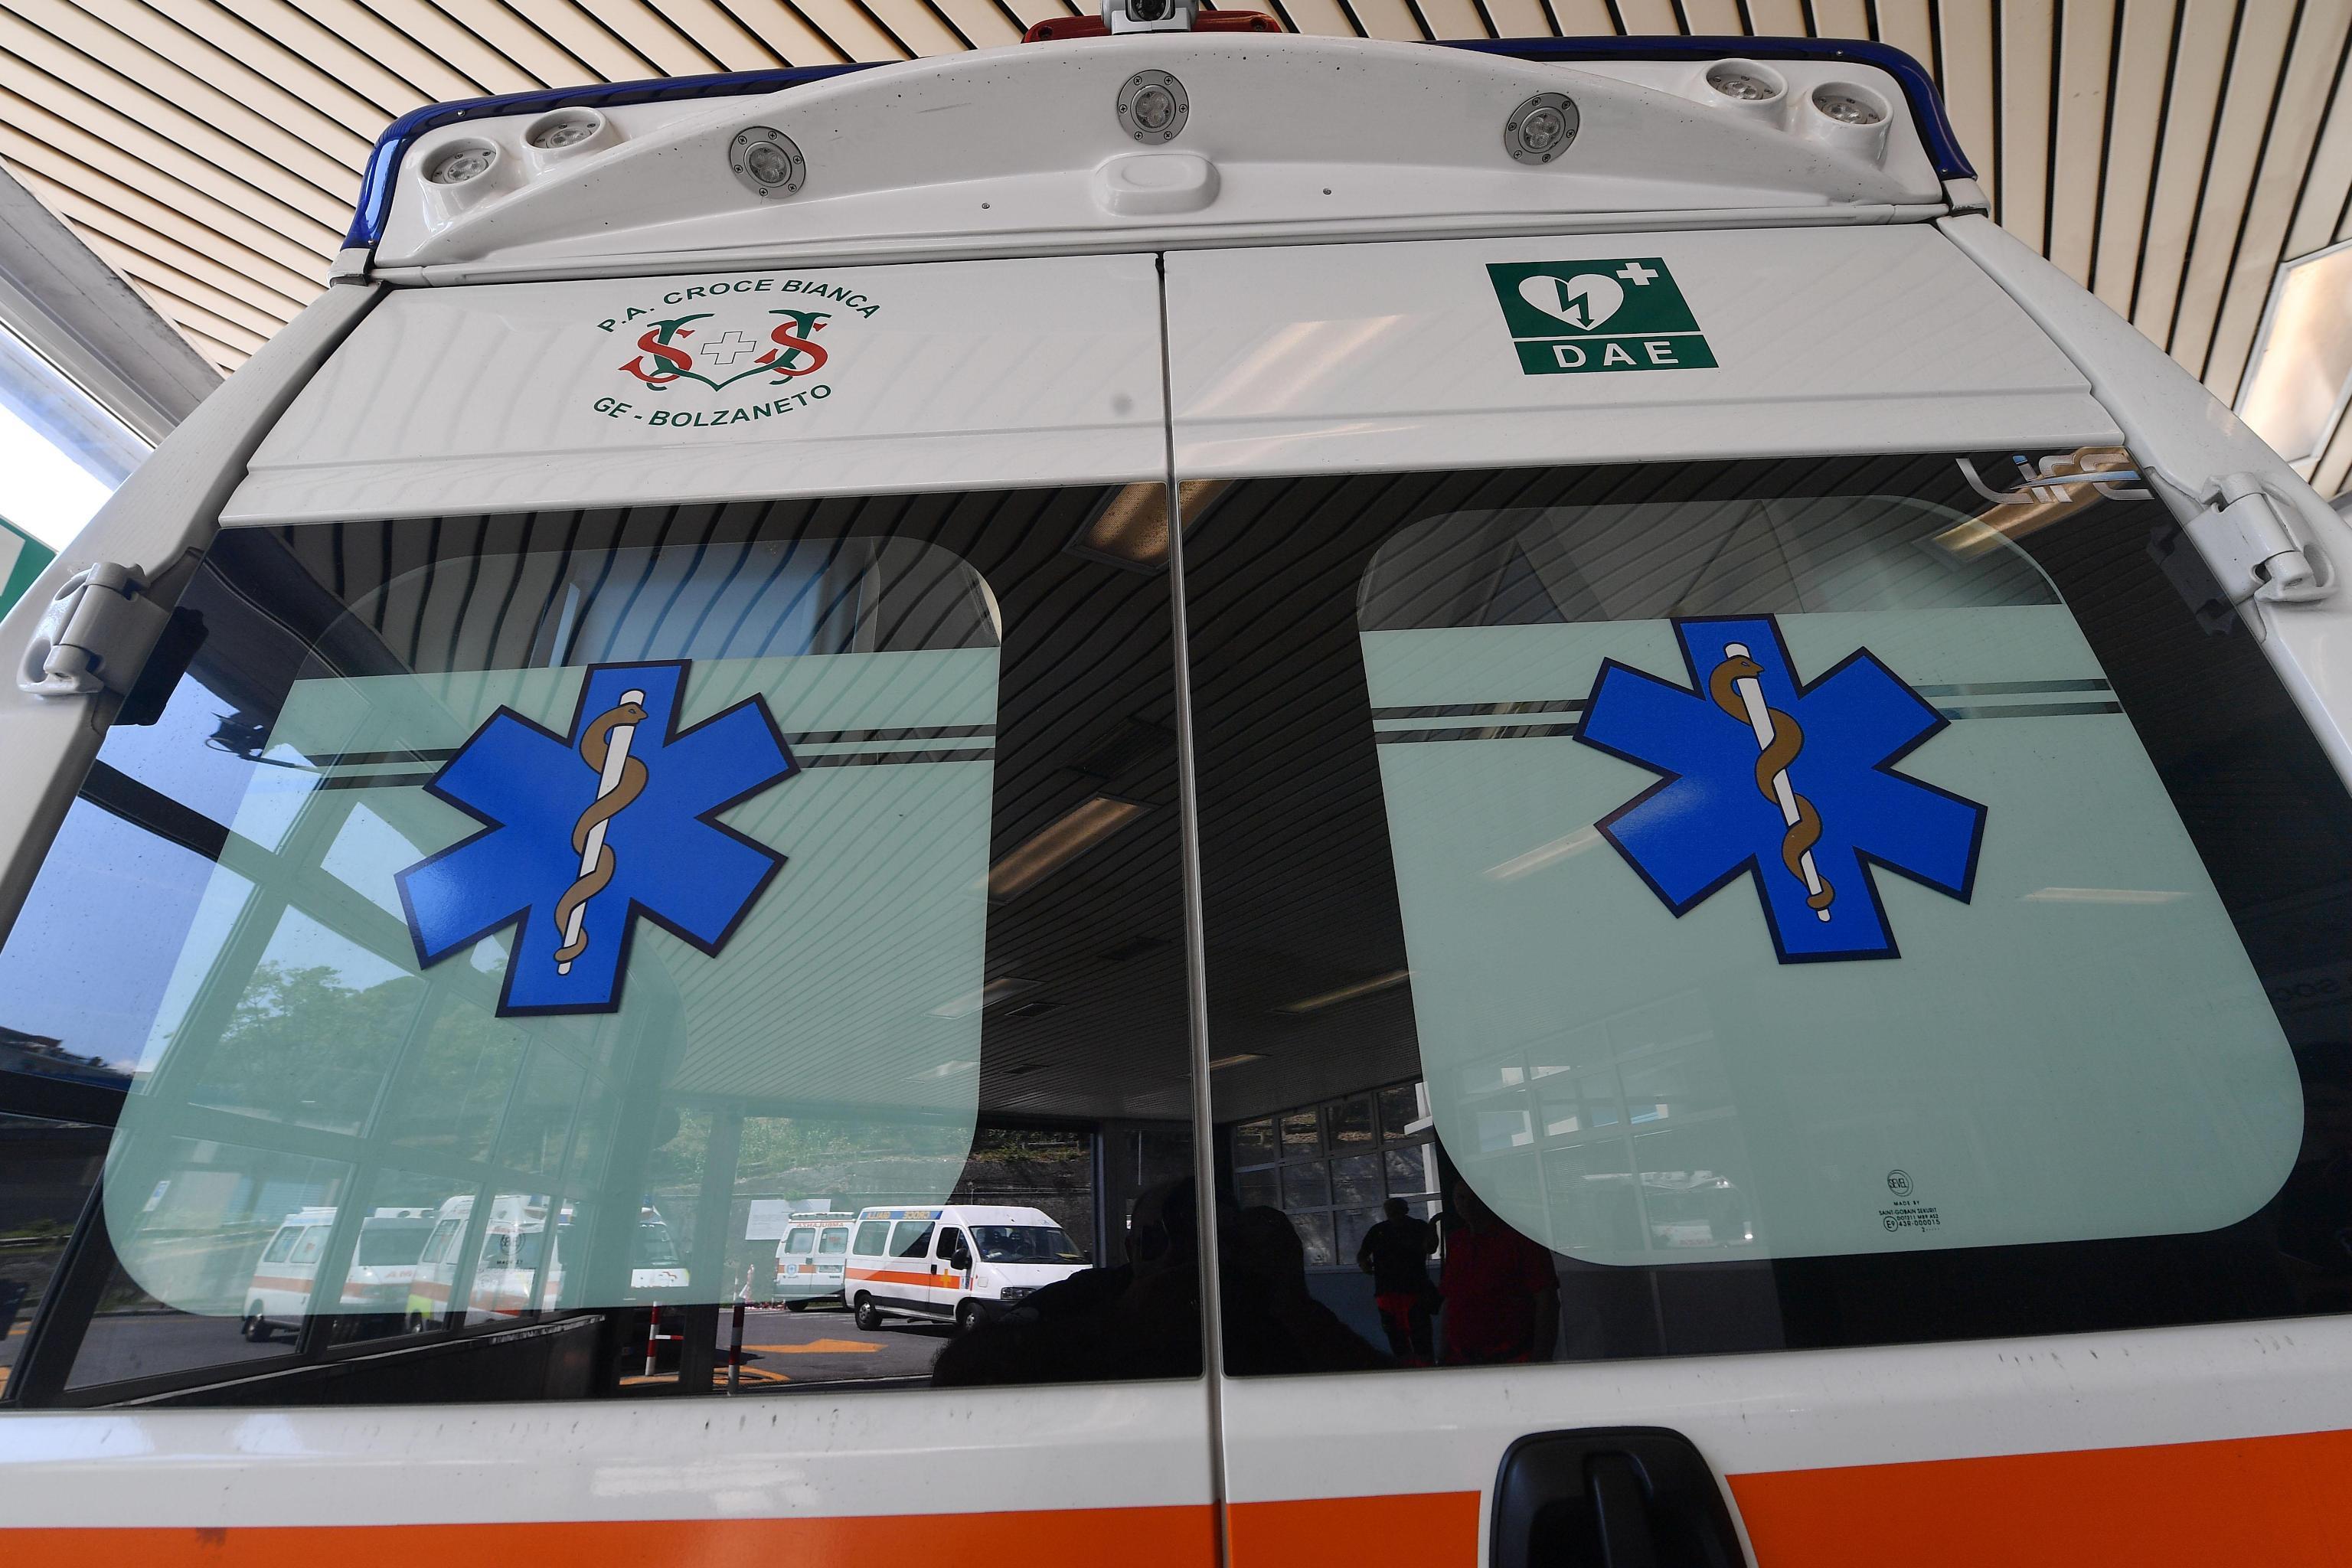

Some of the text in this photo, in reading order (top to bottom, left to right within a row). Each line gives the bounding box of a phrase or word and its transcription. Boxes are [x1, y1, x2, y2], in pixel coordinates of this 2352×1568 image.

[596, 278, 881, 333] P.A. CROCE BIANCA
[1552, 341, 1679, 368] DAE
[648, 384, 832, 428] BOLZANETO
